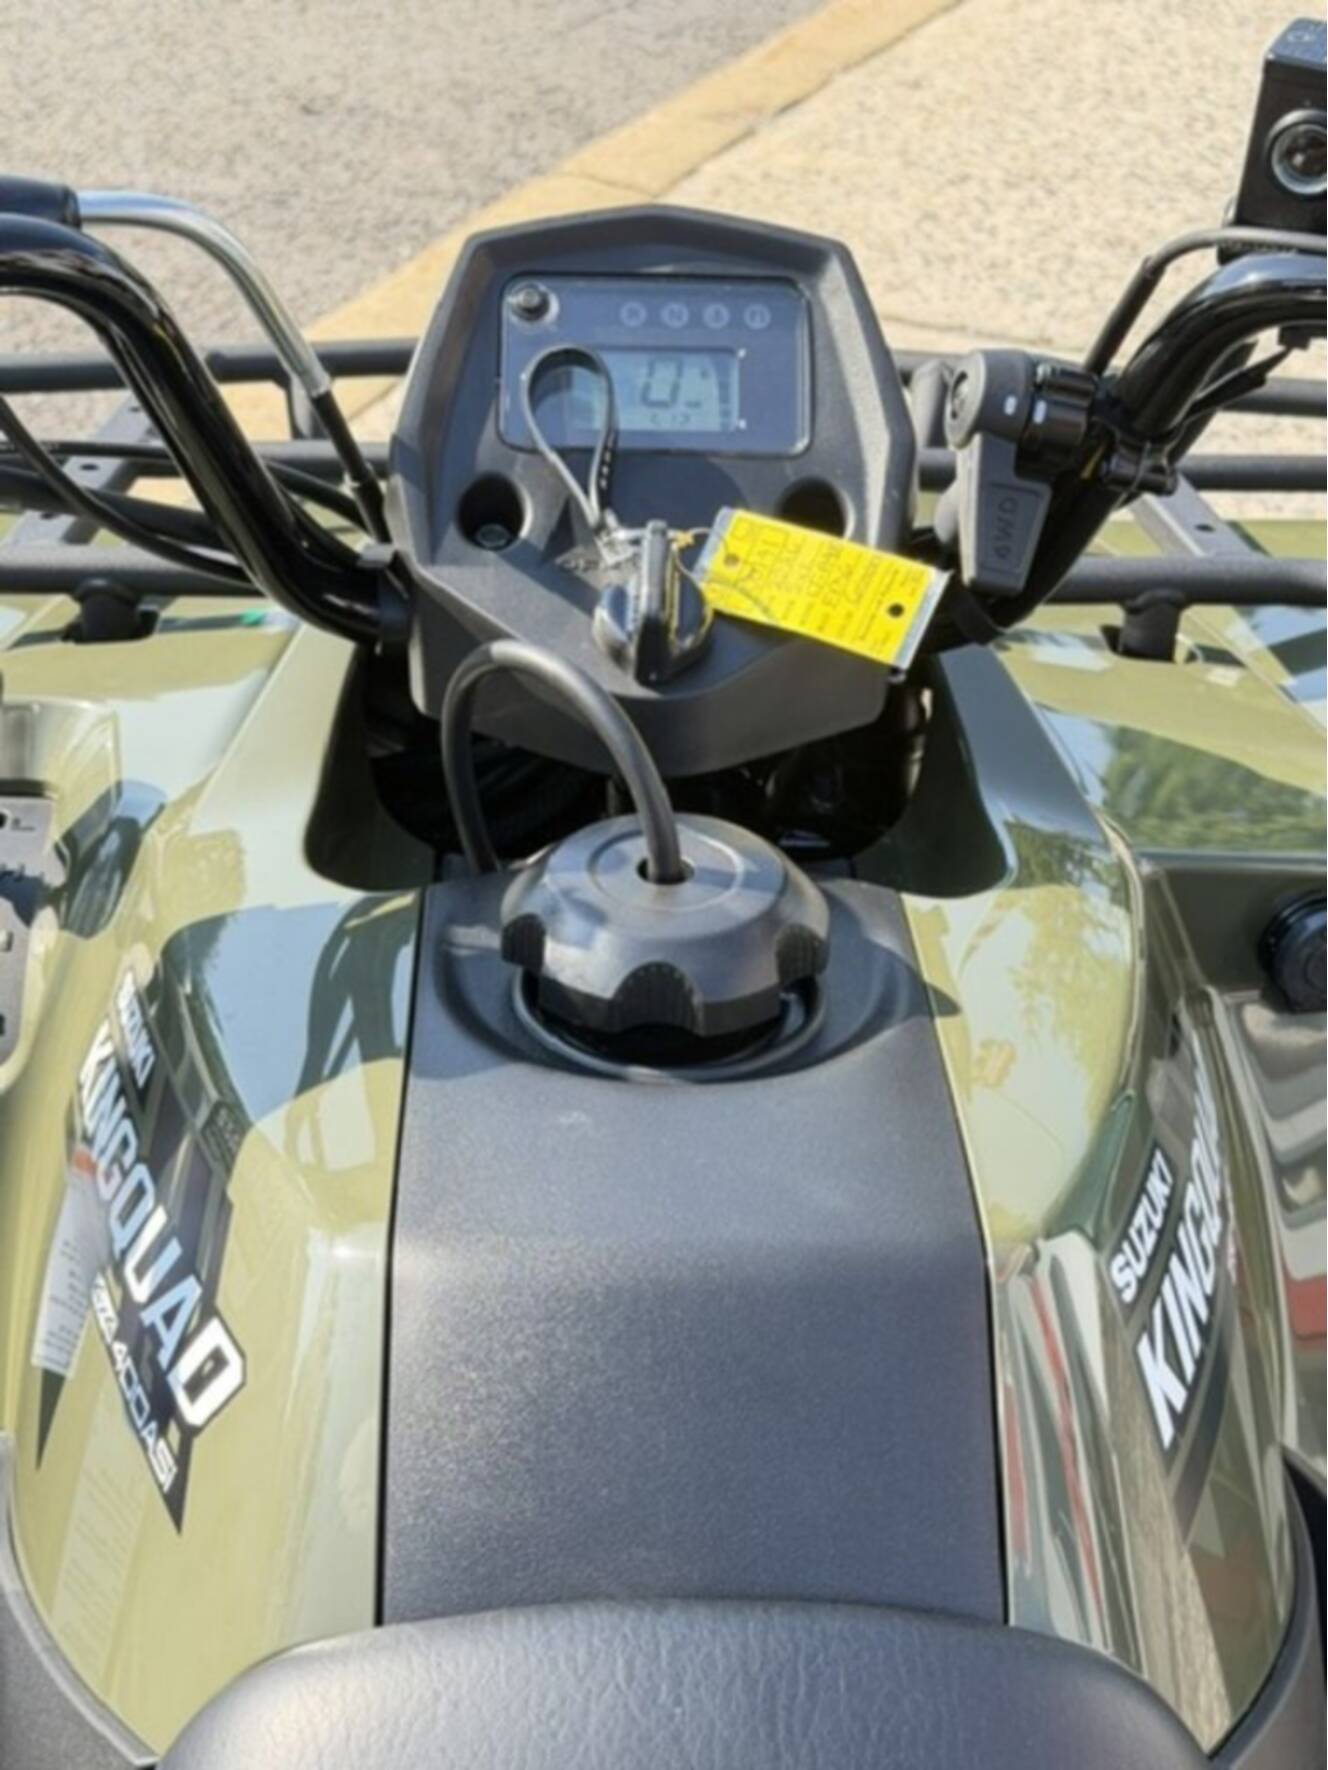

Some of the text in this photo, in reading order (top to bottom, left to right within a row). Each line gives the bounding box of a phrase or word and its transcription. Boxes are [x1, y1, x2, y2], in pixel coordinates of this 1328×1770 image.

[992, 497, 1018, 560] 4WD
[79, 1018, 246, 1429] KINGQUAD
[1110, 1149, 1175, 1304] SUZUKI
